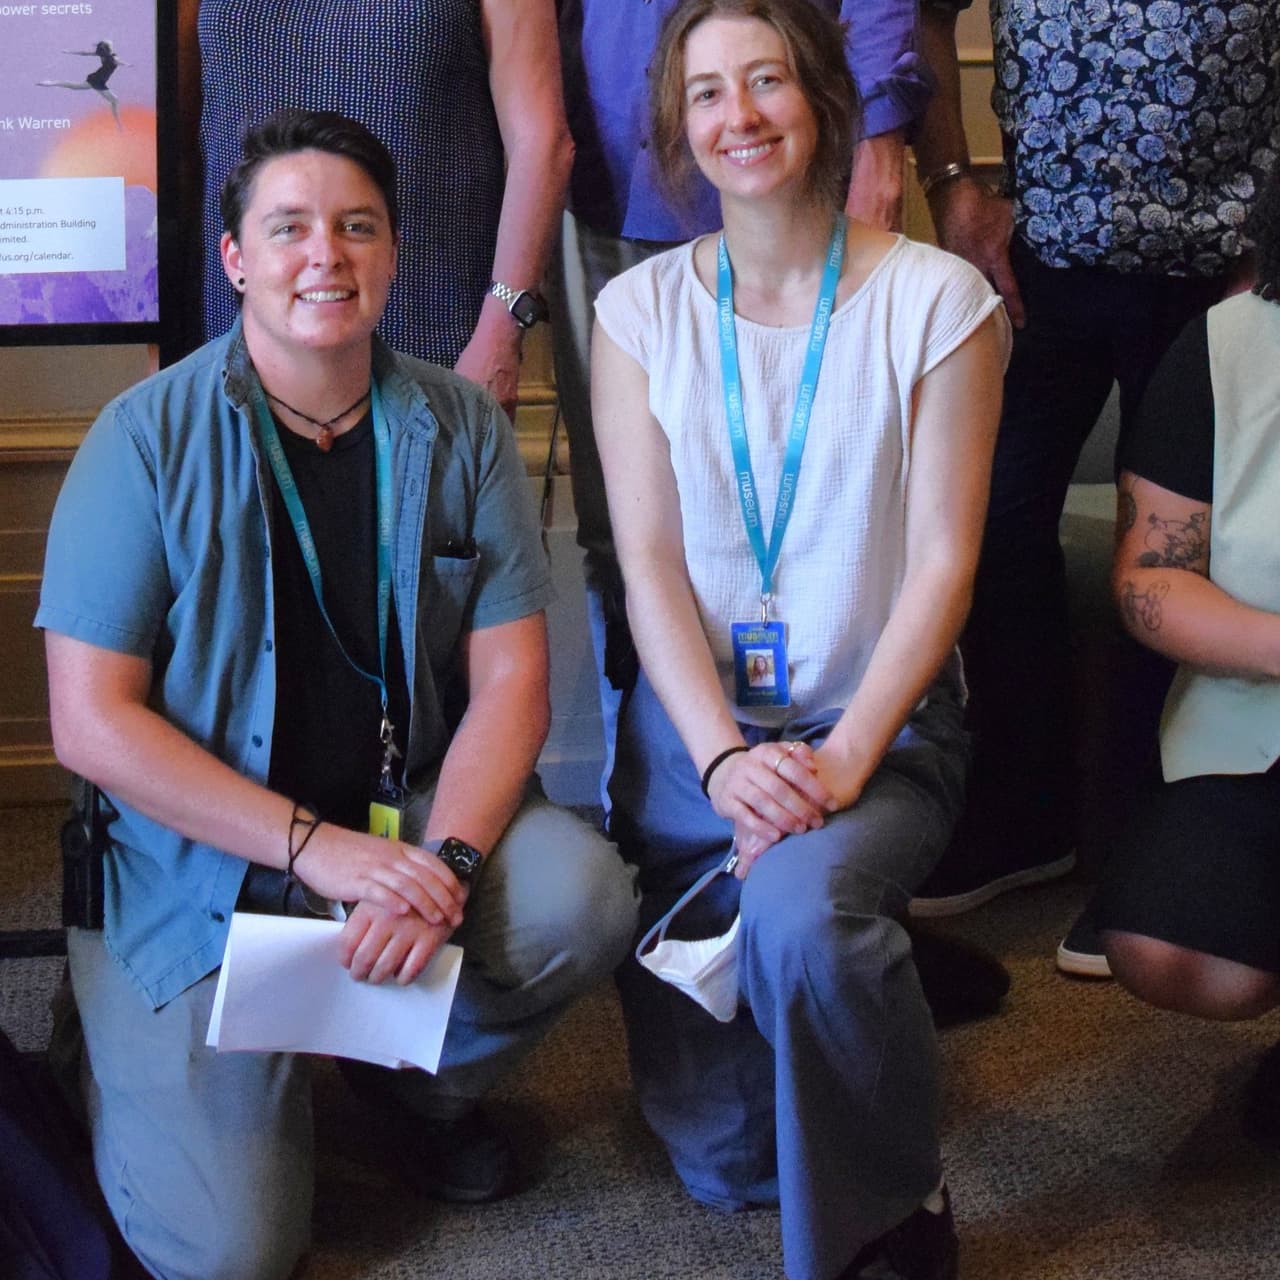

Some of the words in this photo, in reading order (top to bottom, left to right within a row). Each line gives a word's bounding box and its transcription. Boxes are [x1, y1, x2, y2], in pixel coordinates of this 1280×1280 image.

[41, 1, 93, 15] secrets
[18, 116, 71, 130] Warren
[6, 206, 24, 215] 4:15
[26, 207, 45, 216] p.m.
[60, 219, 97, 230] Building
[720, 297, 734, 351] museum
[810, 297, 831, 353] museum
[727, 381, 743, 439] museum
[792, 383, 813, 441] museum
[739, 471, 759, 529] museum
[775, 472, 795, 529] museum
